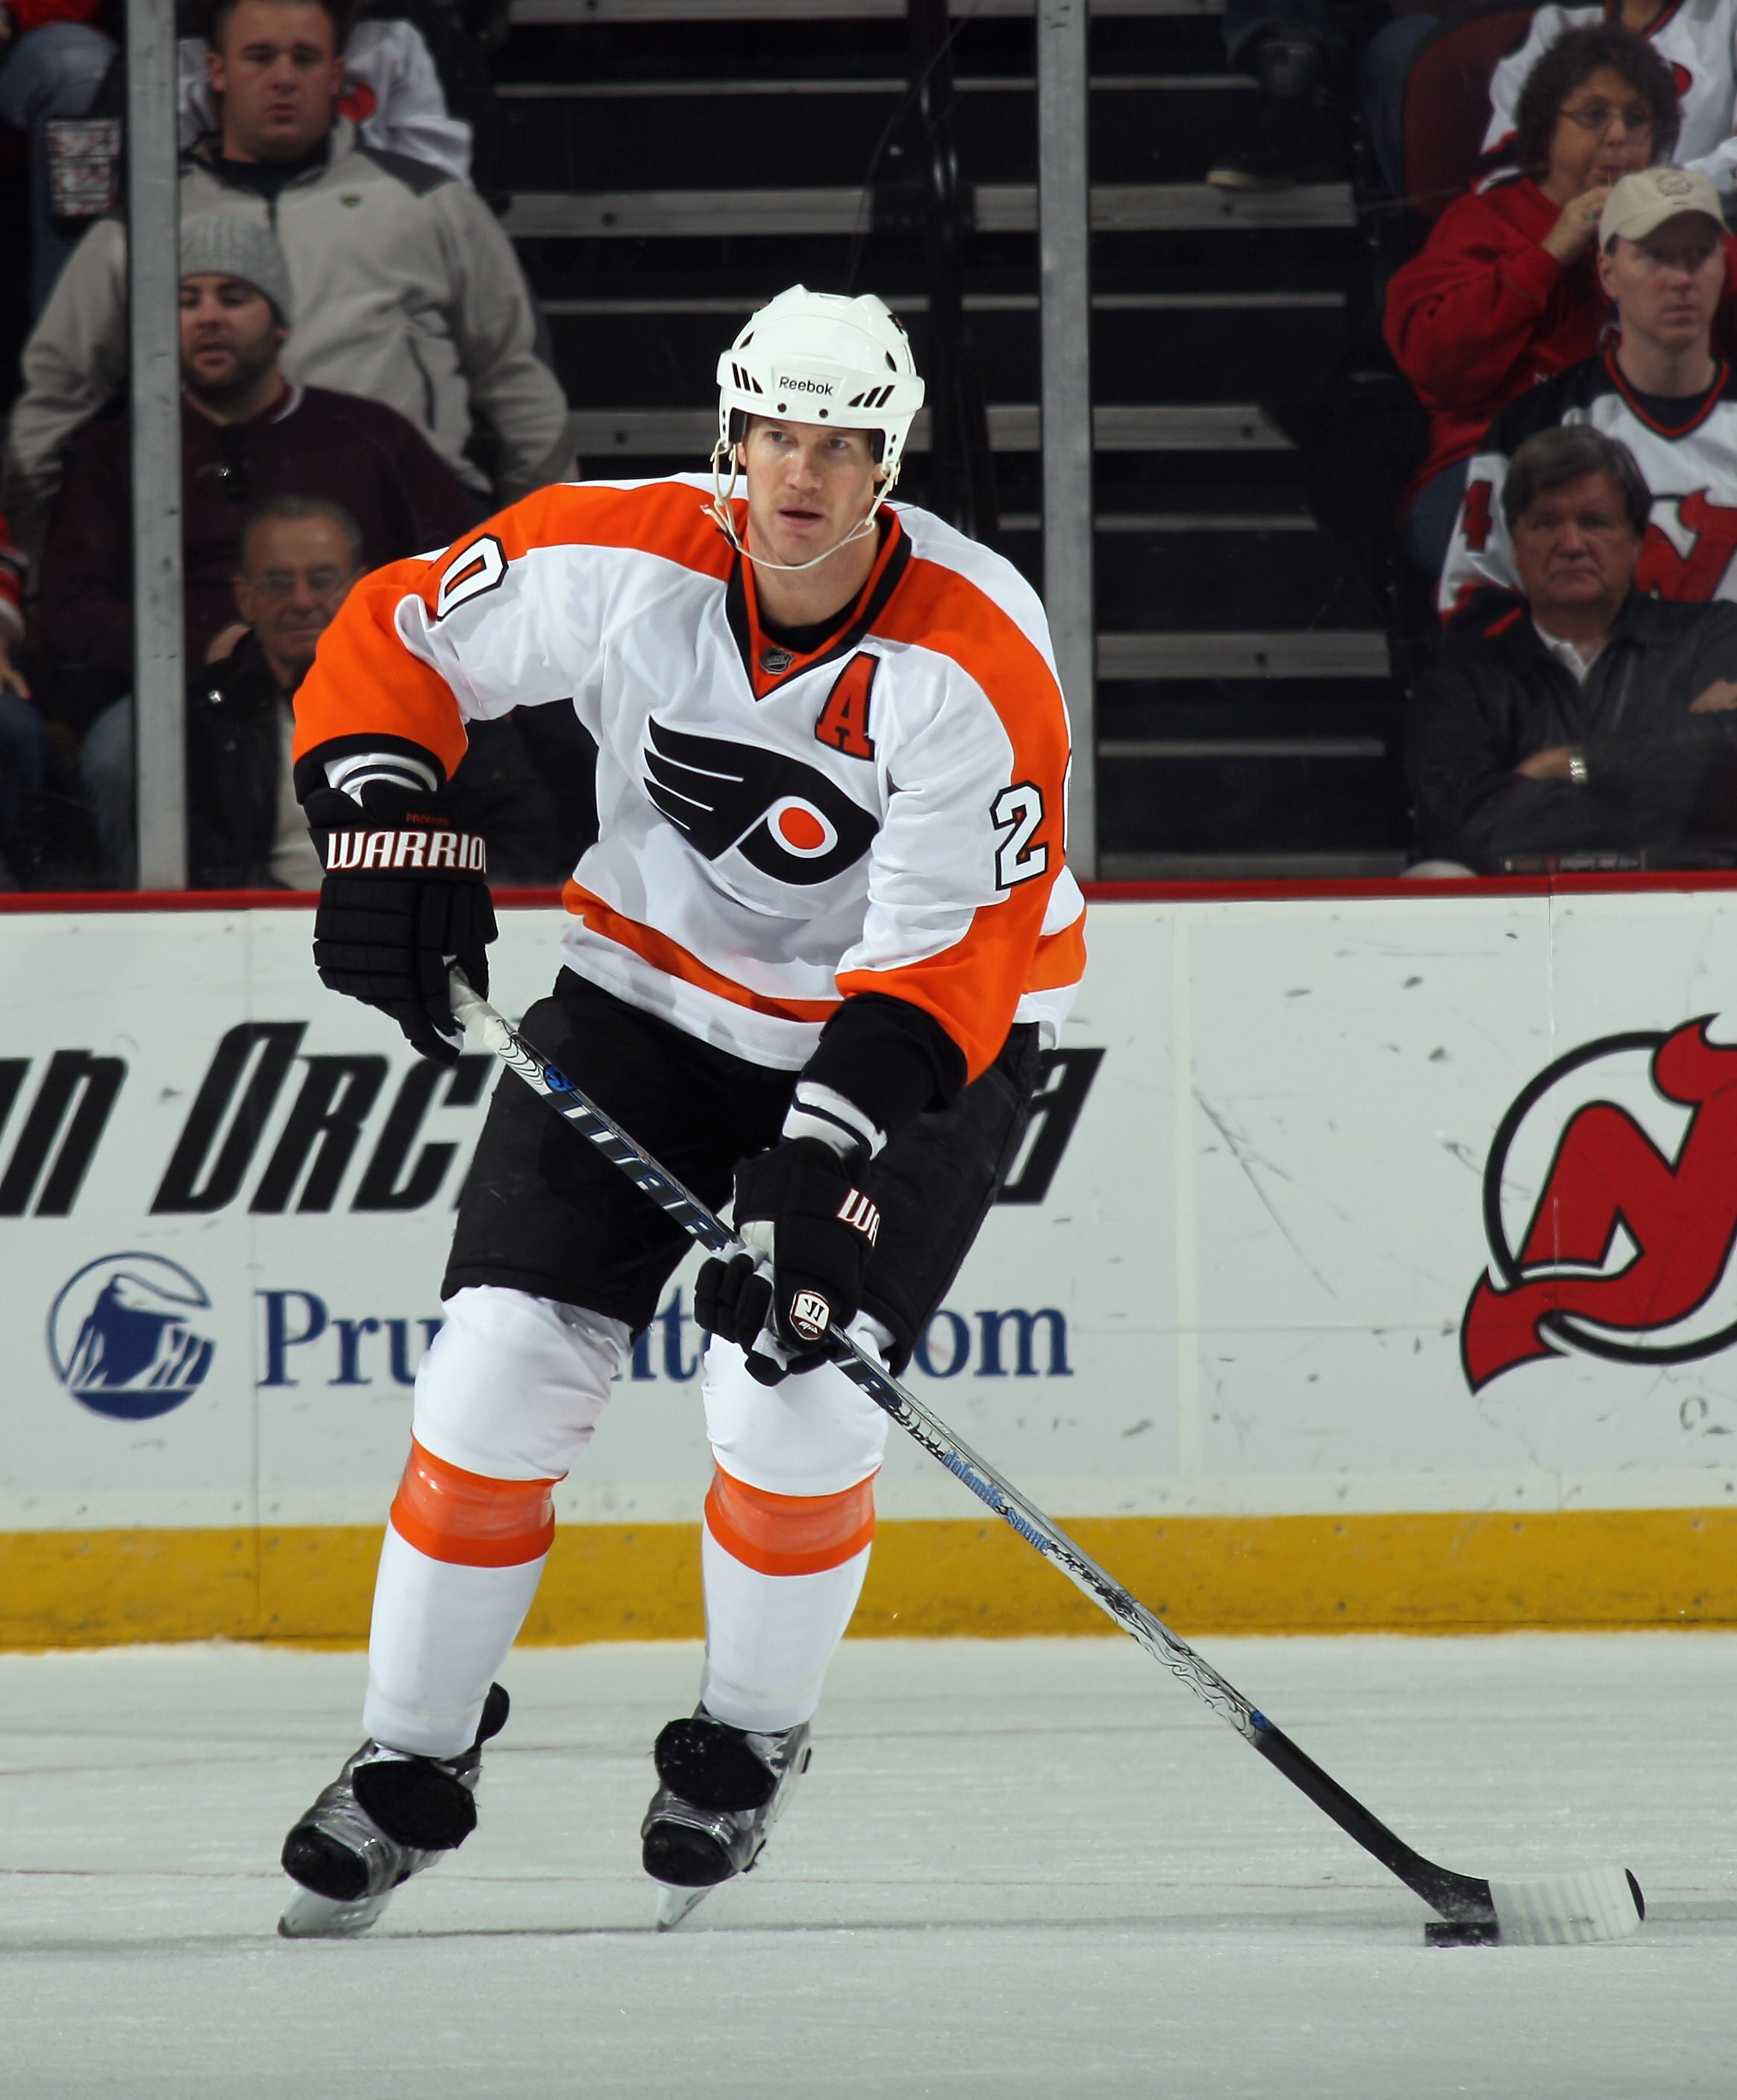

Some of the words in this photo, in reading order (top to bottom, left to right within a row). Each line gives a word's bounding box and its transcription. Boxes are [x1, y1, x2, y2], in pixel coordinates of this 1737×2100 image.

[778, 375, 834, 396] Reebok
[814, 651, 880, 762] A
[326, 830, 486, 874] WARRIO
[989, 751, 1072, 892] 2
[146, 1021, 499, 1216] ORC
